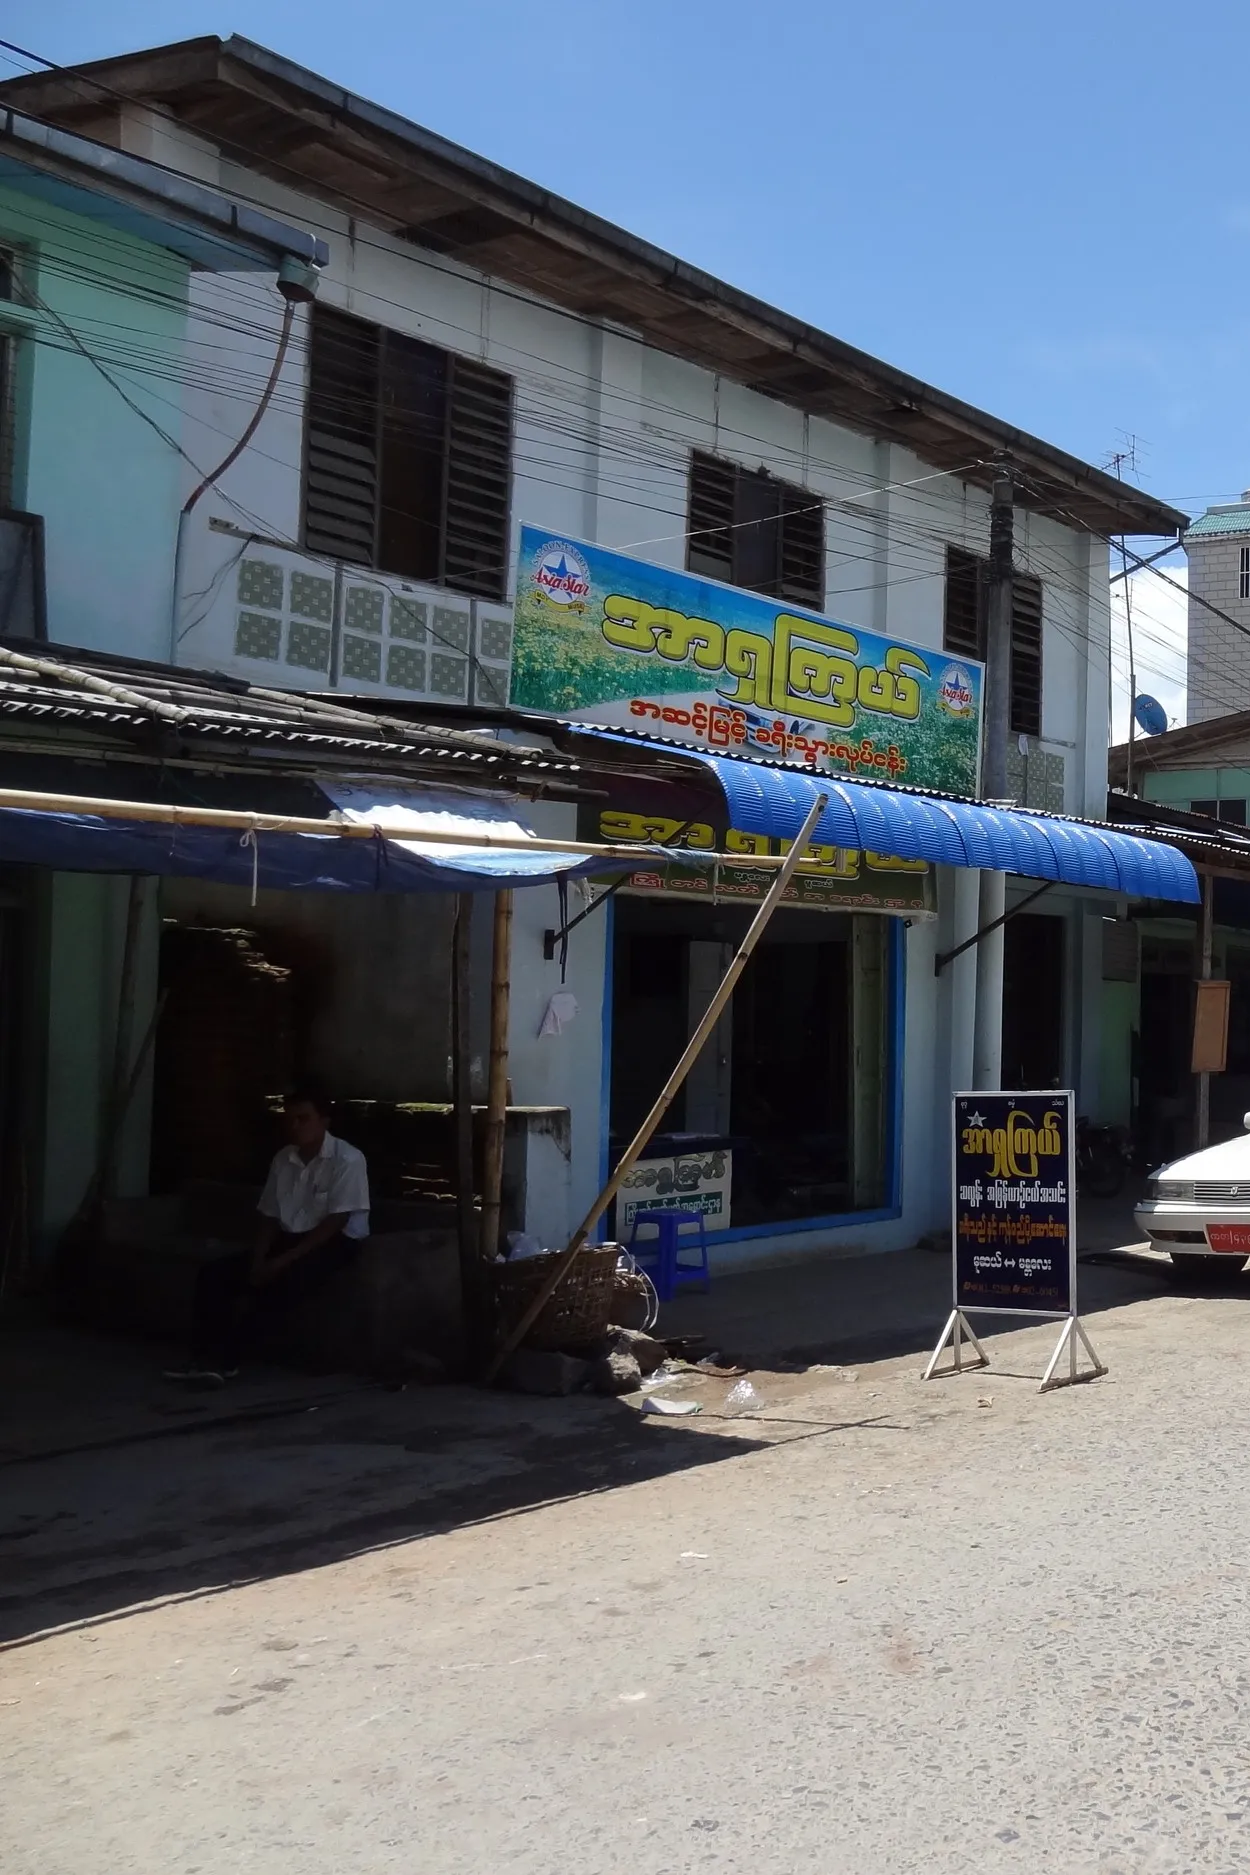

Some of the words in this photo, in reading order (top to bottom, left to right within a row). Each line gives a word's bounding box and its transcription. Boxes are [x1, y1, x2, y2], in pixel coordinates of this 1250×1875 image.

[530, 566, 563, 591] Asia
[562, 573, 590, 596] Star
[601, 593, 932, 727] အာရှကြယ်
[629, 698, 748, 747] အဆင့်မြင့်
[962, 1110, 1062, 1178] အာရှကြယ်
